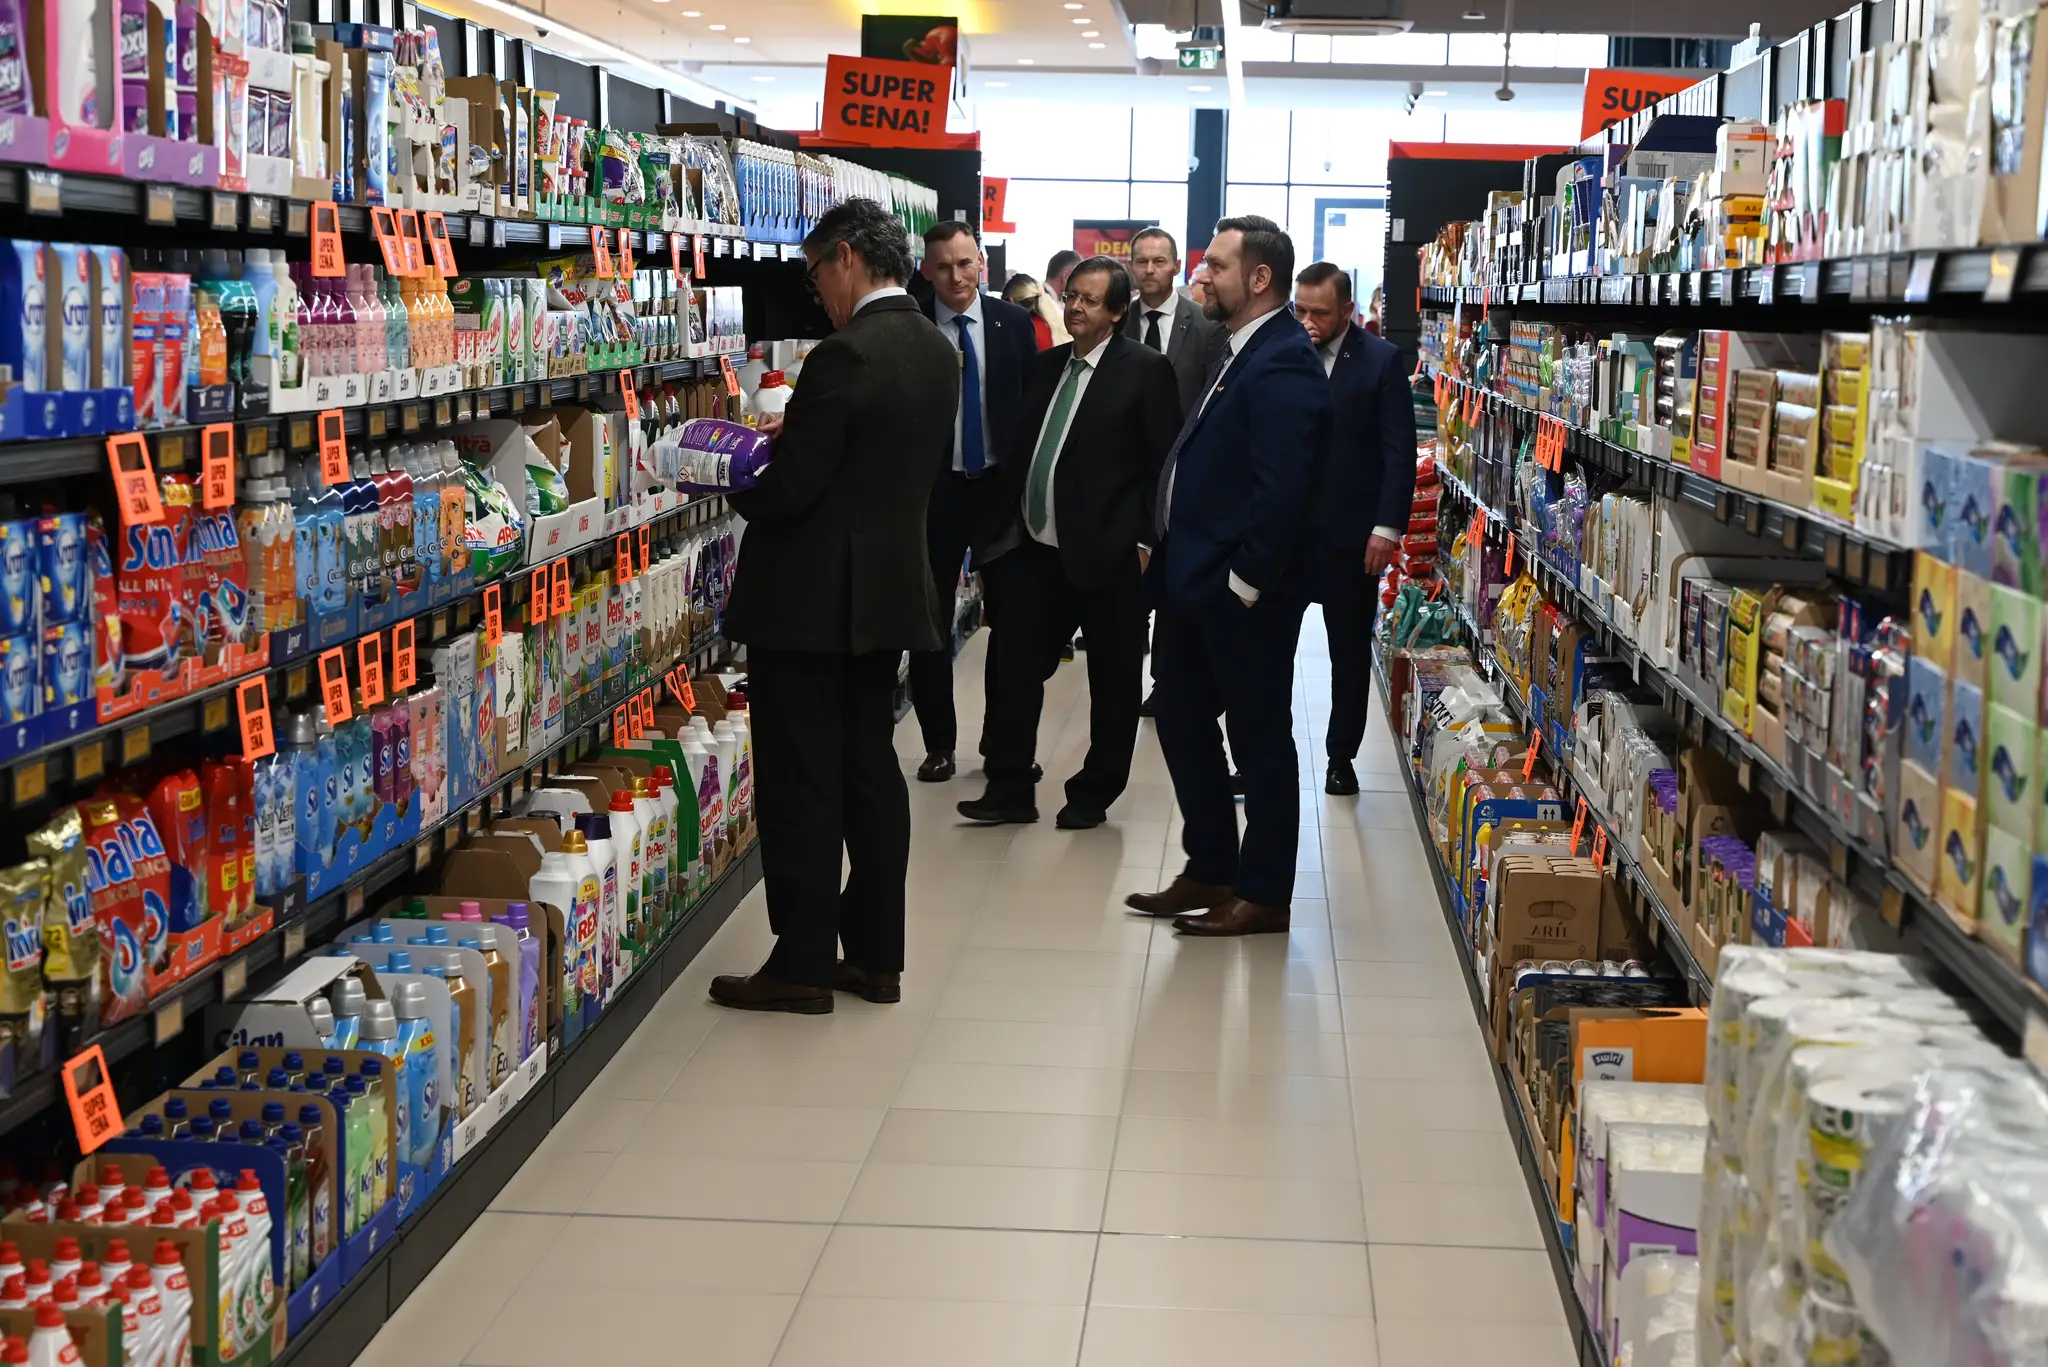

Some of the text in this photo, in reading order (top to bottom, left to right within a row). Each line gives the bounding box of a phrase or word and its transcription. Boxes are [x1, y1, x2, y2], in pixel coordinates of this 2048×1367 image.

[0, 60, 21, 92] xy
[842, 70, 936, 104] SUPER
[1602, 86, 1672, 112] SUP
[840, 102, 930, 135] CENA!
[455, 281, 471, 291] SAVO
[145, 578, 159, 593] IN
[607, 593, 625, 627] Persil
[478, 694, 494, 740] REX
[508, 711, 520, 735] ELEN
[583, 883, 594, 894] XXL
[577, 906, 598, 944] REX
[1594, 1052, 1623, 1065] swirl
